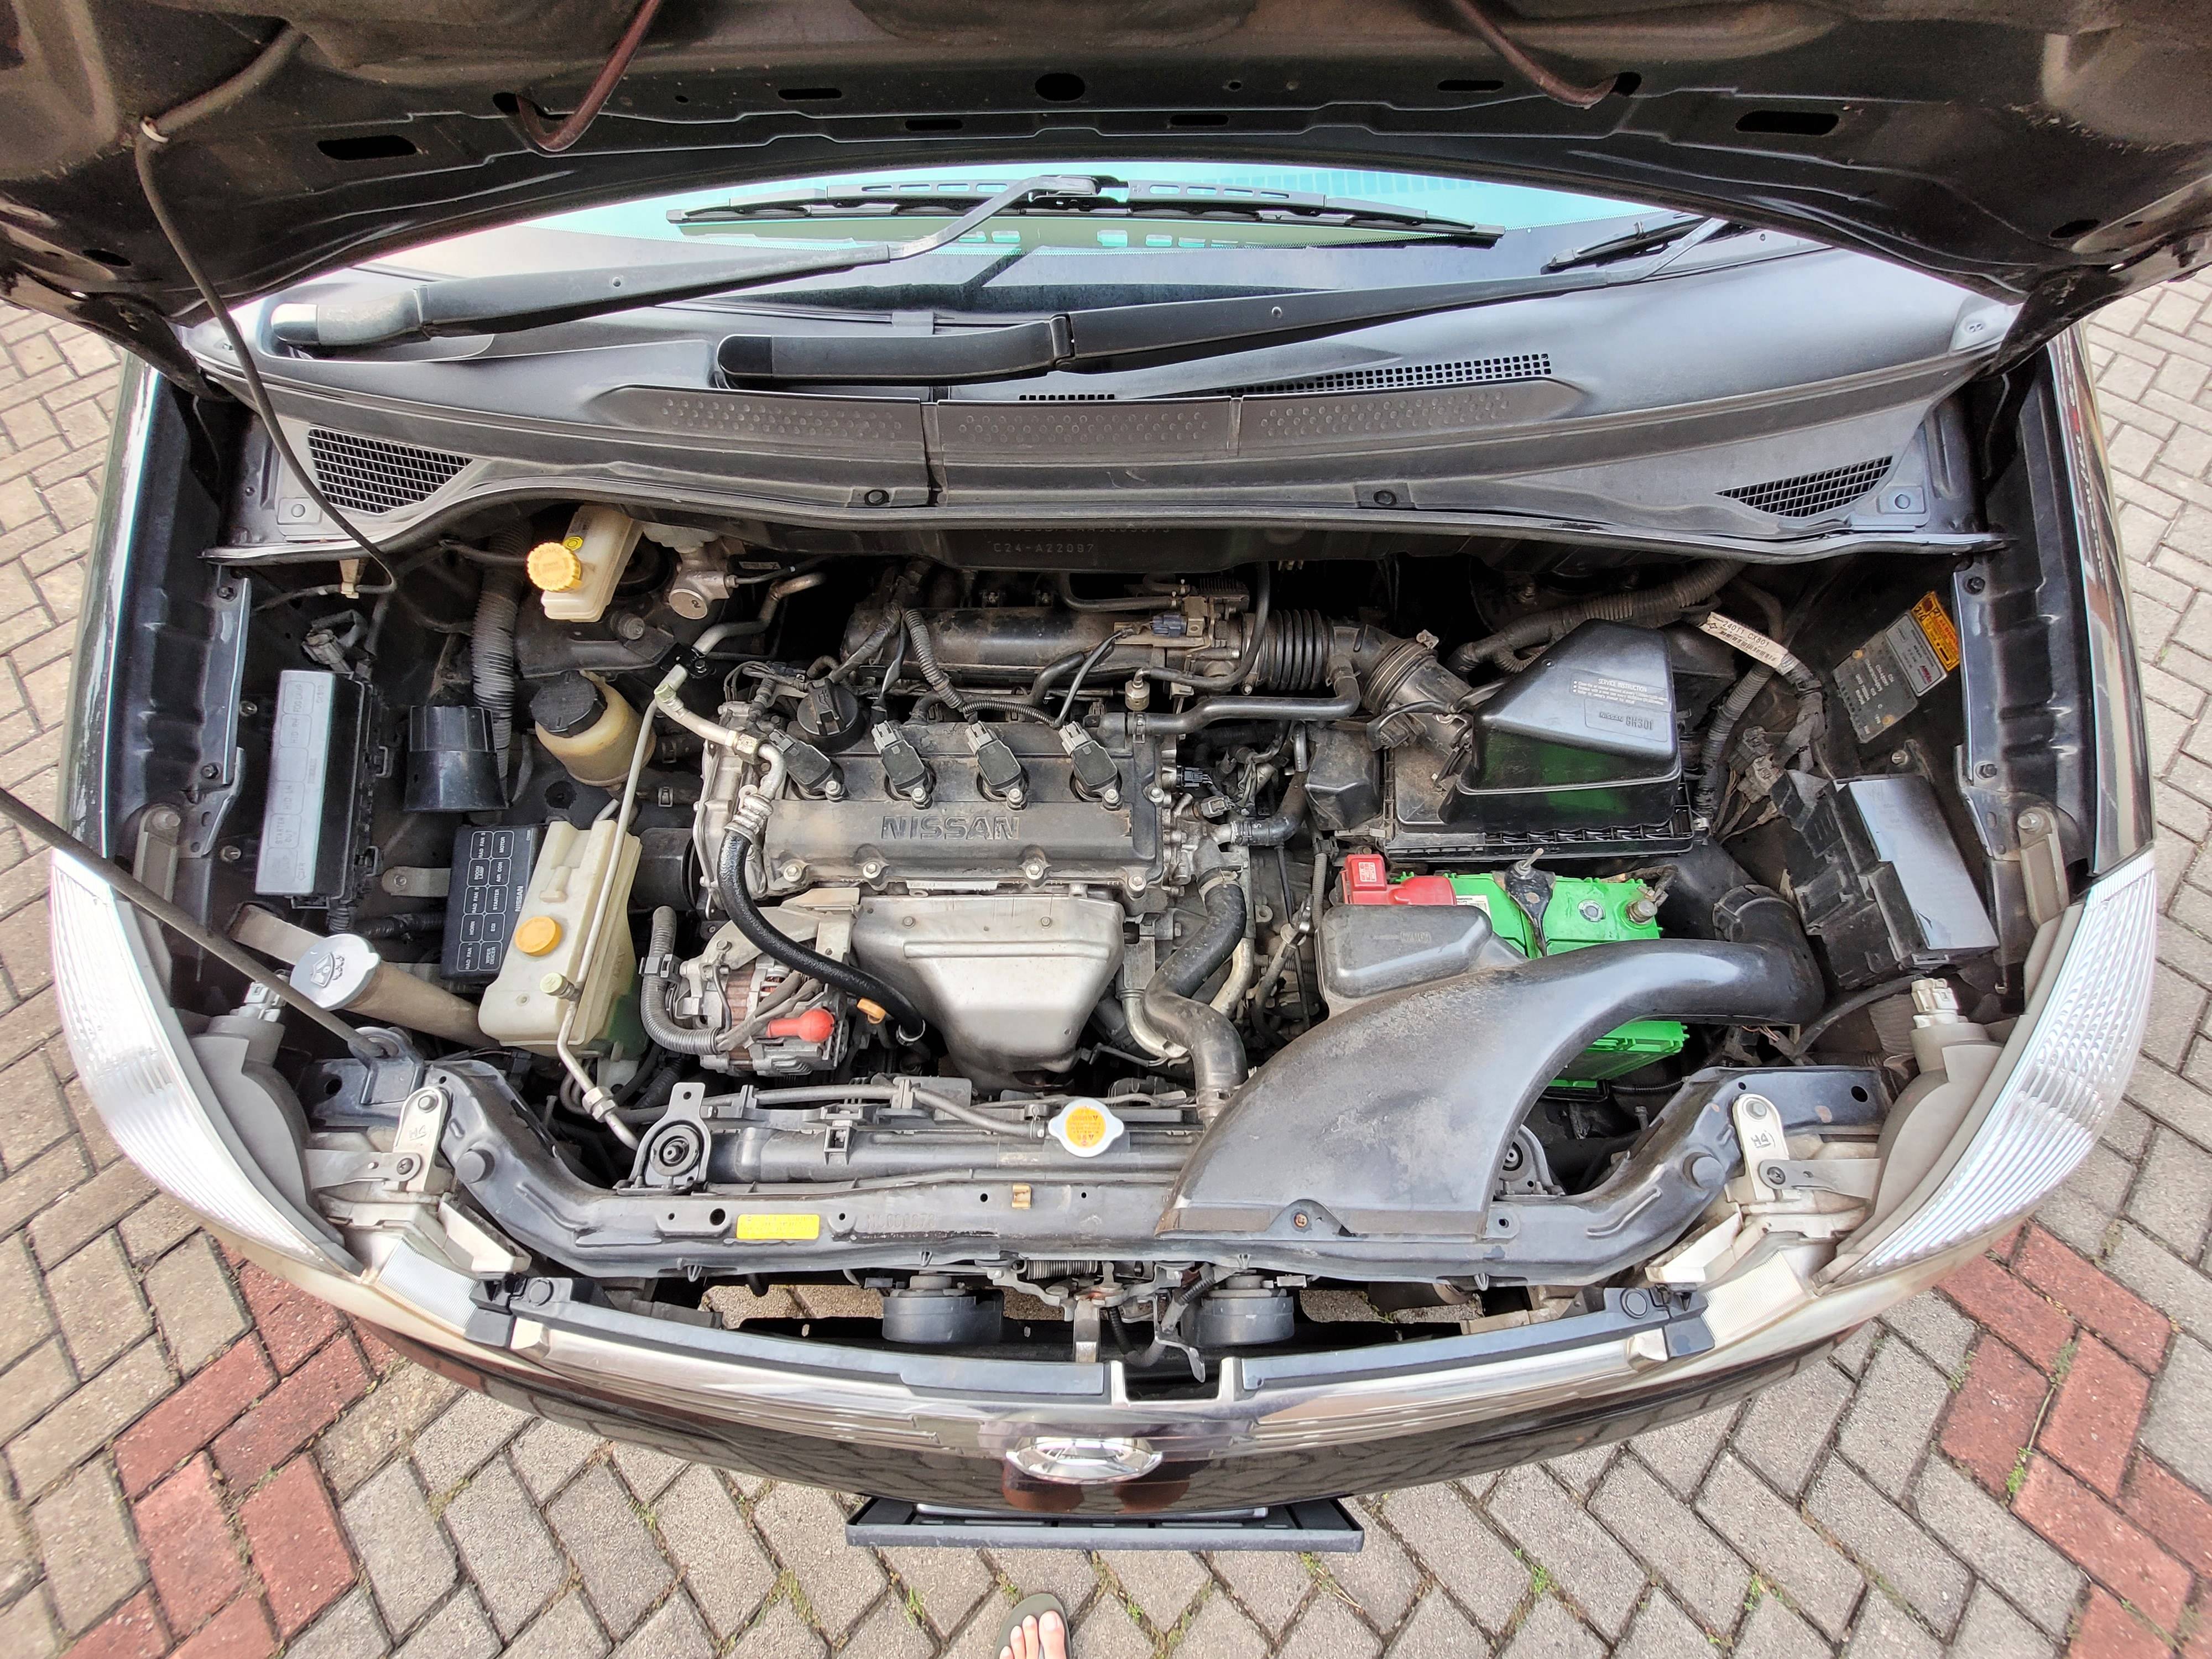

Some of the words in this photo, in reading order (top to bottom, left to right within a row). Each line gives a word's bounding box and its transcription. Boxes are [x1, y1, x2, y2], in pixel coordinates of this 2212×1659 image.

[1747, 632, 1770, 648] CX801
[1598, 679, 1616, 687] SERVICE
[1618, 682, 1647, 692] INSTRUCTION
[1599, 712, 1623, 722] NISSAN
[880, 815, 1020, 840] NISSAN
[515, 885, 524, 912] NISSAN
